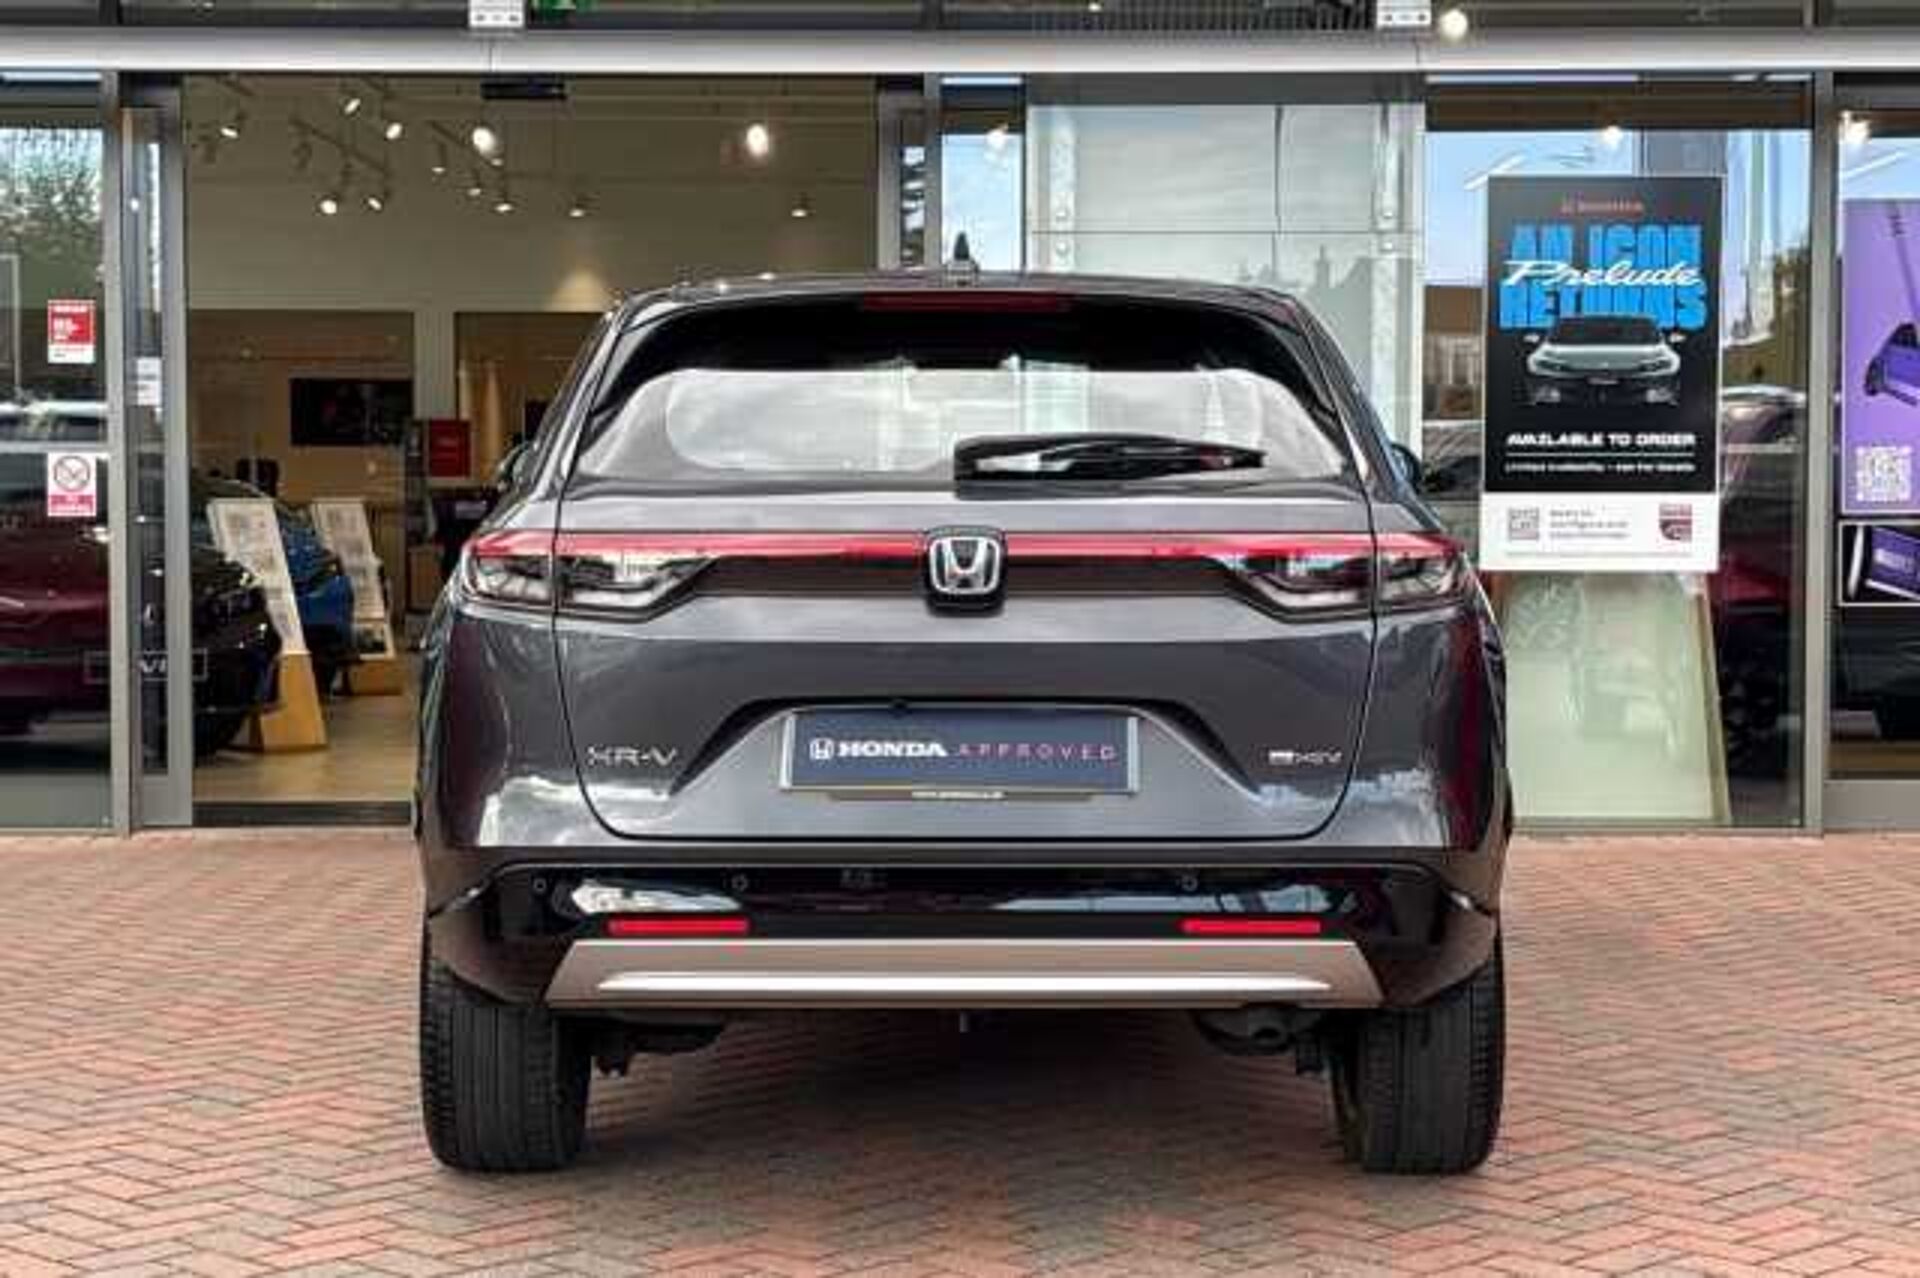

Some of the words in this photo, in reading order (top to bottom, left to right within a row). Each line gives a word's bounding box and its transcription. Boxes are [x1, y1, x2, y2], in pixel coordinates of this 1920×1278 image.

[1588, 223, 1702, 268] ICON
[1503, 259, 1703, 286] Prelude
[1498, 279, 1708, 329] RETURNS
[1506, 432, 1604, 446] AVAILABLE
[1607, 432, 1633, 446] TO
[1635, 432, 1696, 446] ORDER
[839, 740, 949, 758] HONDA
[959, 742, 1117, 761] APPROVED
